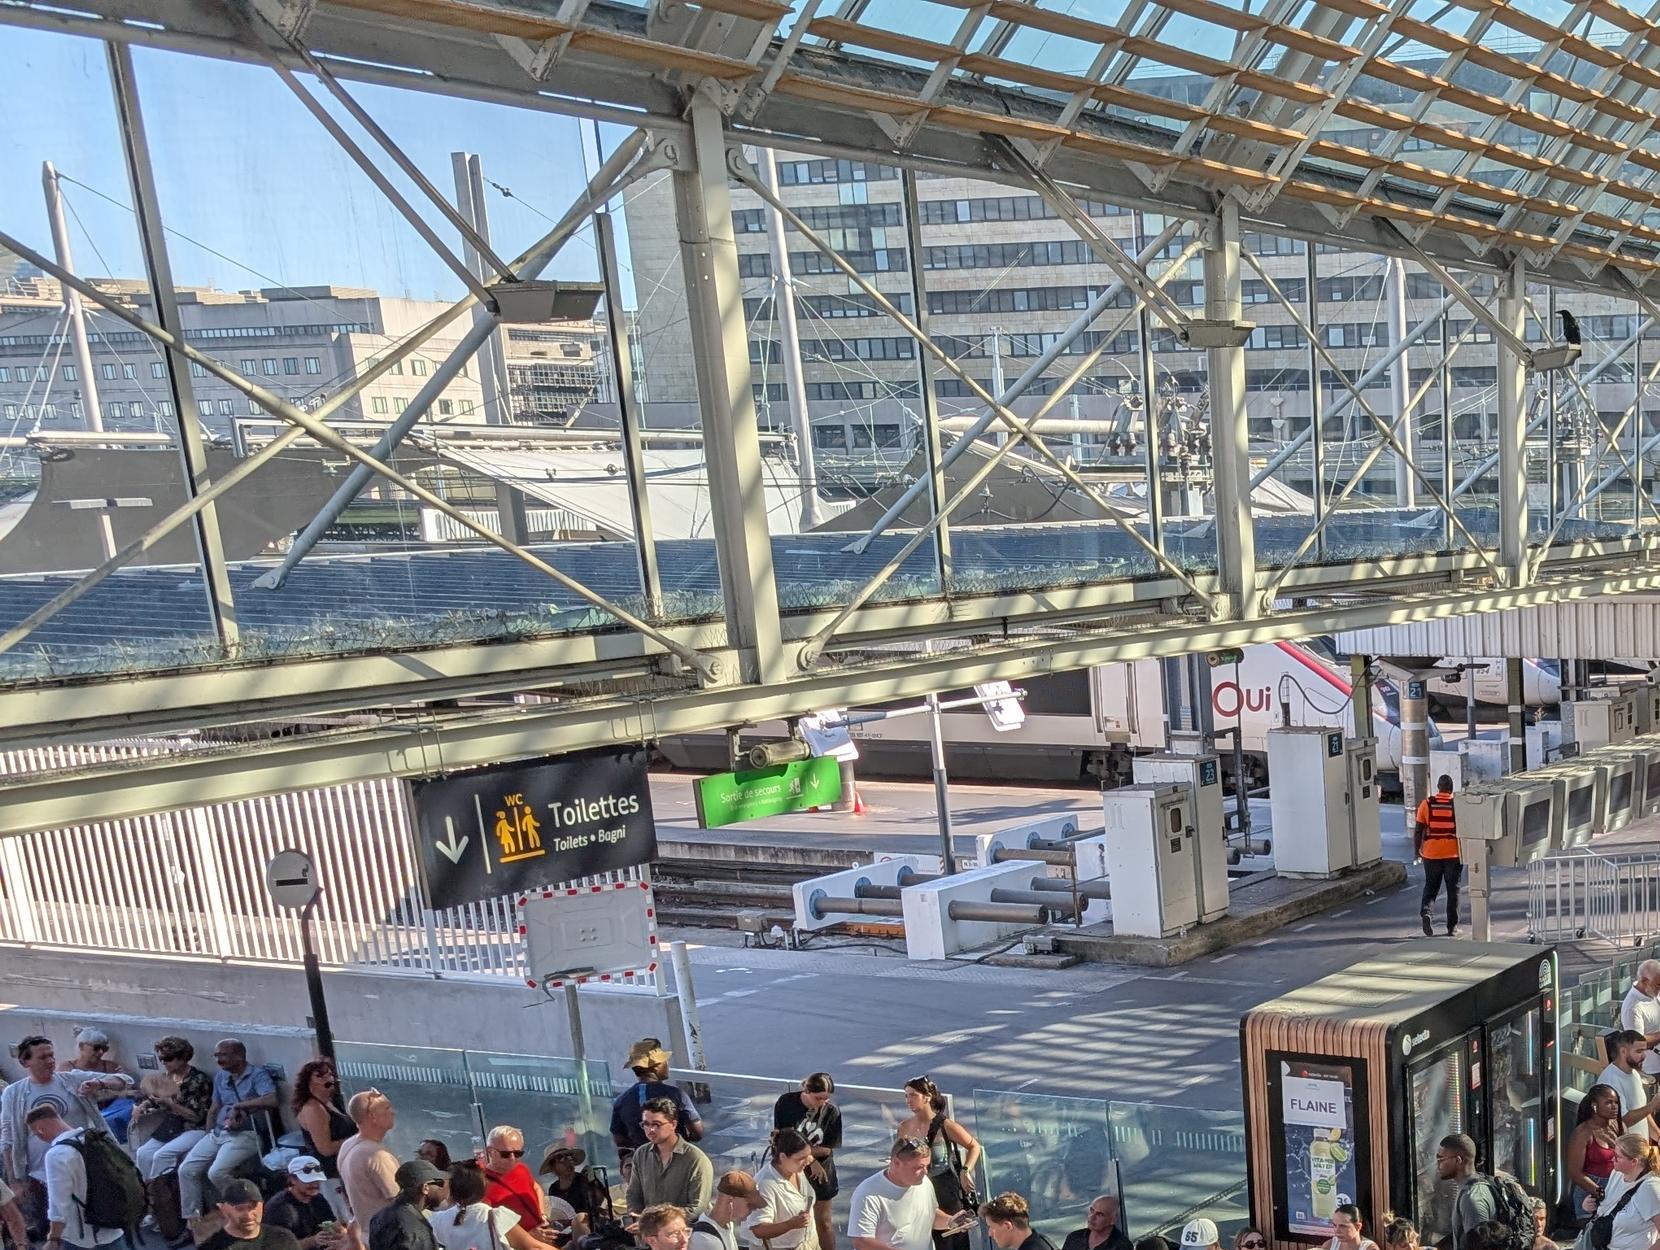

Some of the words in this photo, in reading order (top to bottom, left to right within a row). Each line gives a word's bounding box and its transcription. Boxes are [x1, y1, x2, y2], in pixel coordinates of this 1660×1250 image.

[1410, 687, 1422, 697] 21
[1205, 769, 1215, 782] 23
[504, 792, 525, 807] WC
[720, 789, 743, 804] Sortie
[744, 788, 754, 799] de
[755, 784, 781, 796] secours
[548, 794, 640, 828] Toilettes
[553, 836, 589, 853] Toilets
[598, 824, 627, 844] Bagni
[1290, 1098, 1337, 1114] FLAINE
[1185, 1231, 1198, 1243] 65
